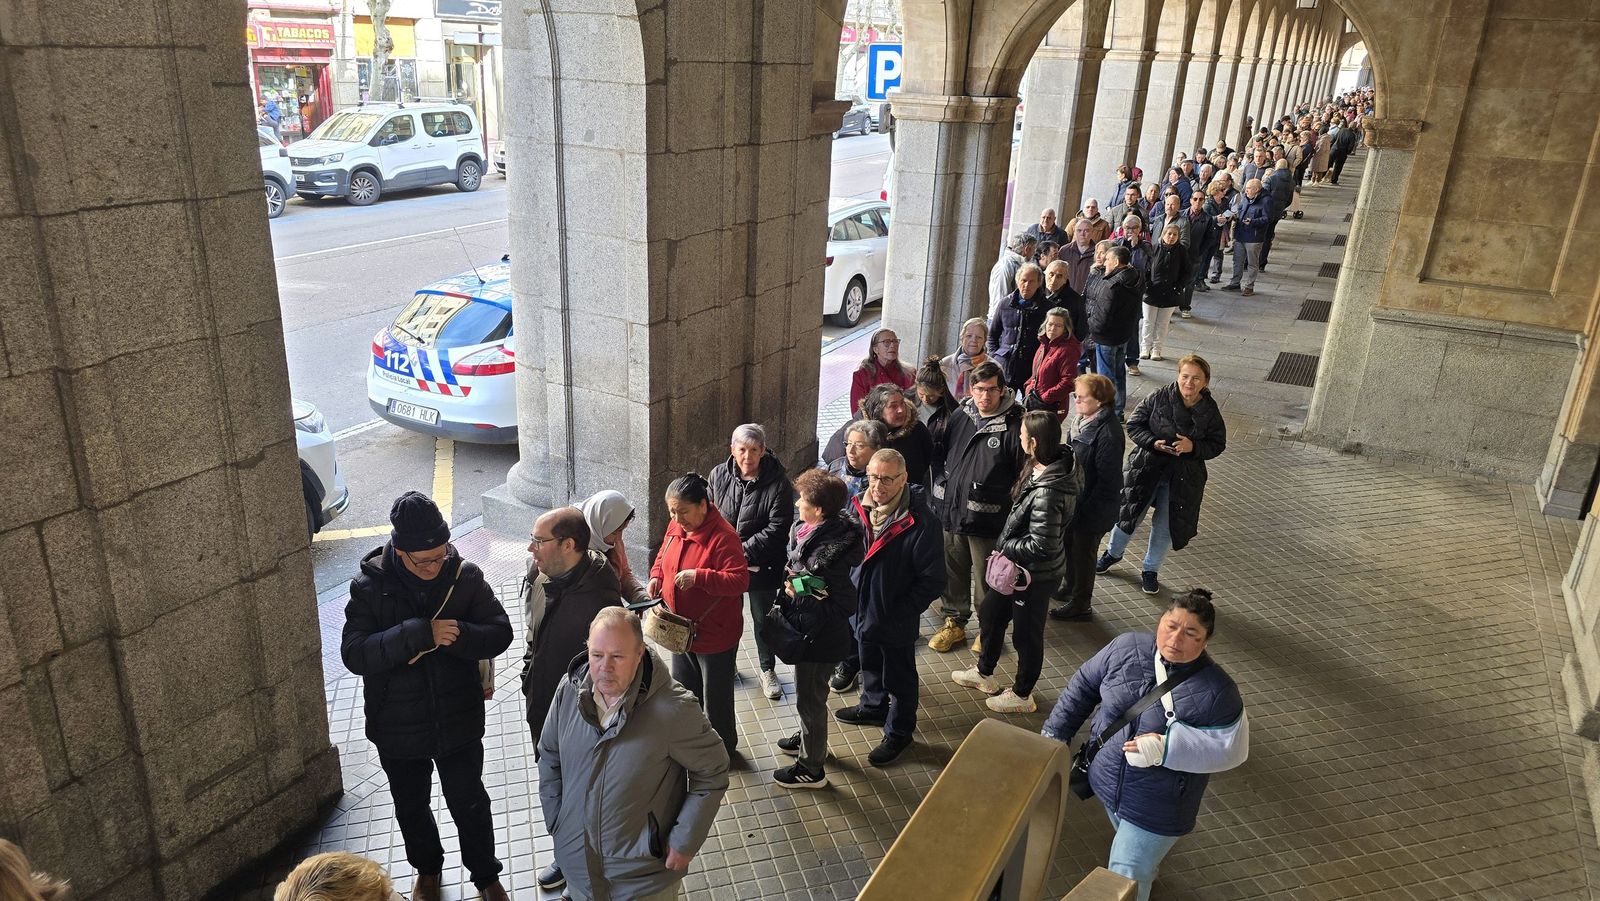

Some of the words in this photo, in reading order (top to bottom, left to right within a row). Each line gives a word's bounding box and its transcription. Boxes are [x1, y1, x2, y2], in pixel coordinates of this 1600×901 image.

[277, 26, 330, 39] TABACOS
[875, 50, 903, 94] P
[384, 350, 410, 373] 112
[397, 375, 411, 385] Local
[397, 403, 416, 417] 0681
[419, 409, 435, 422] HLK
